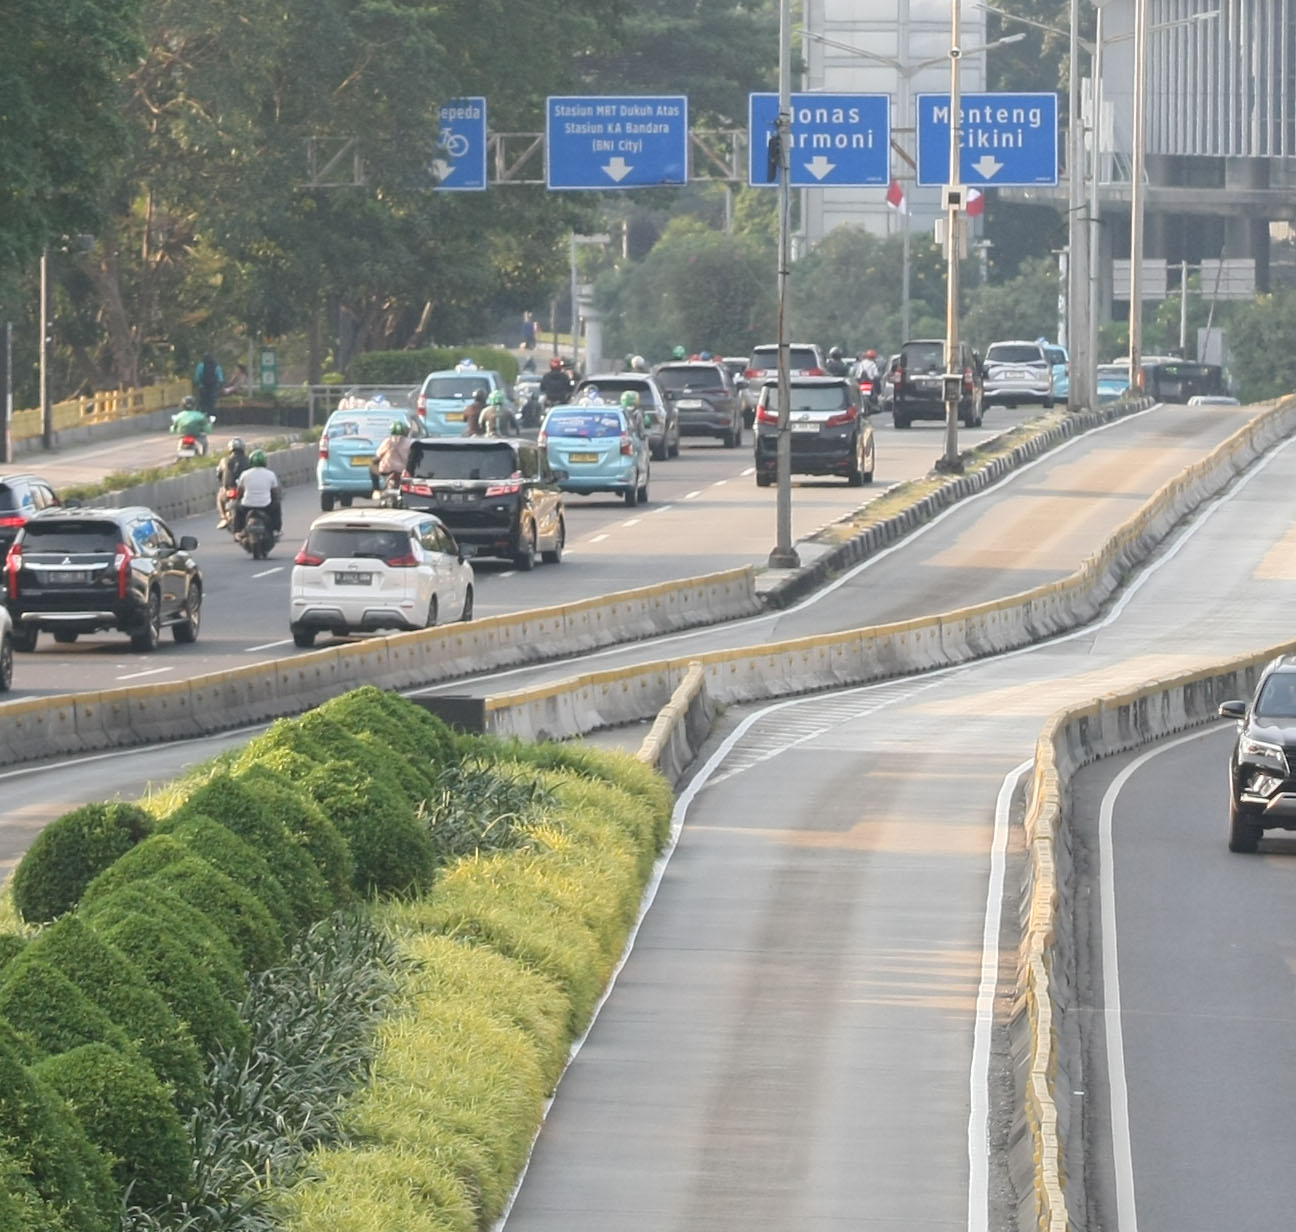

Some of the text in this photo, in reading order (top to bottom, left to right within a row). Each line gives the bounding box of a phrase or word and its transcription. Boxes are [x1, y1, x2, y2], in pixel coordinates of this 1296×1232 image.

[554, 104, 681, 117] Stasiun MRT Dukuh Atas
[564, 122, 670, 134] Stasiun KA Bandara
